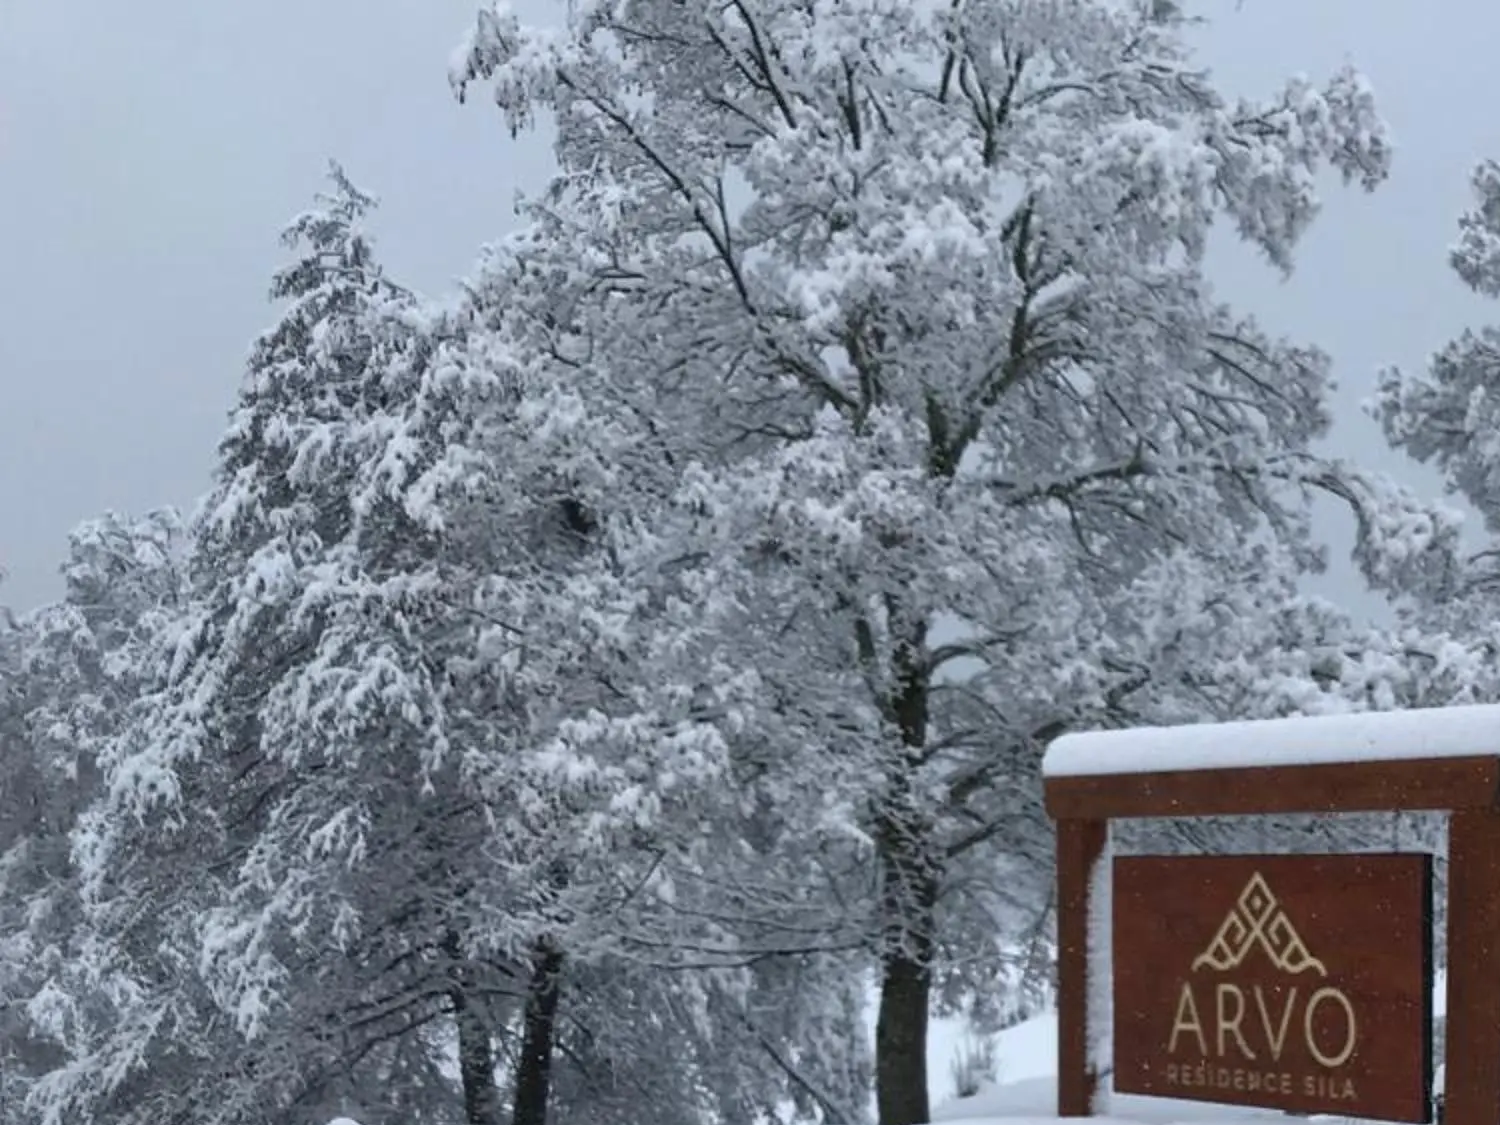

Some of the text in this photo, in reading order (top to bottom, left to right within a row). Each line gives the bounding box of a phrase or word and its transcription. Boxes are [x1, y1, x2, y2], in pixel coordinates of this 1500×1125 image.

[1168, 982, 1356, 1067] ARVO
[1167, 1063, 1358, 1099] RESIDENCE SILA
